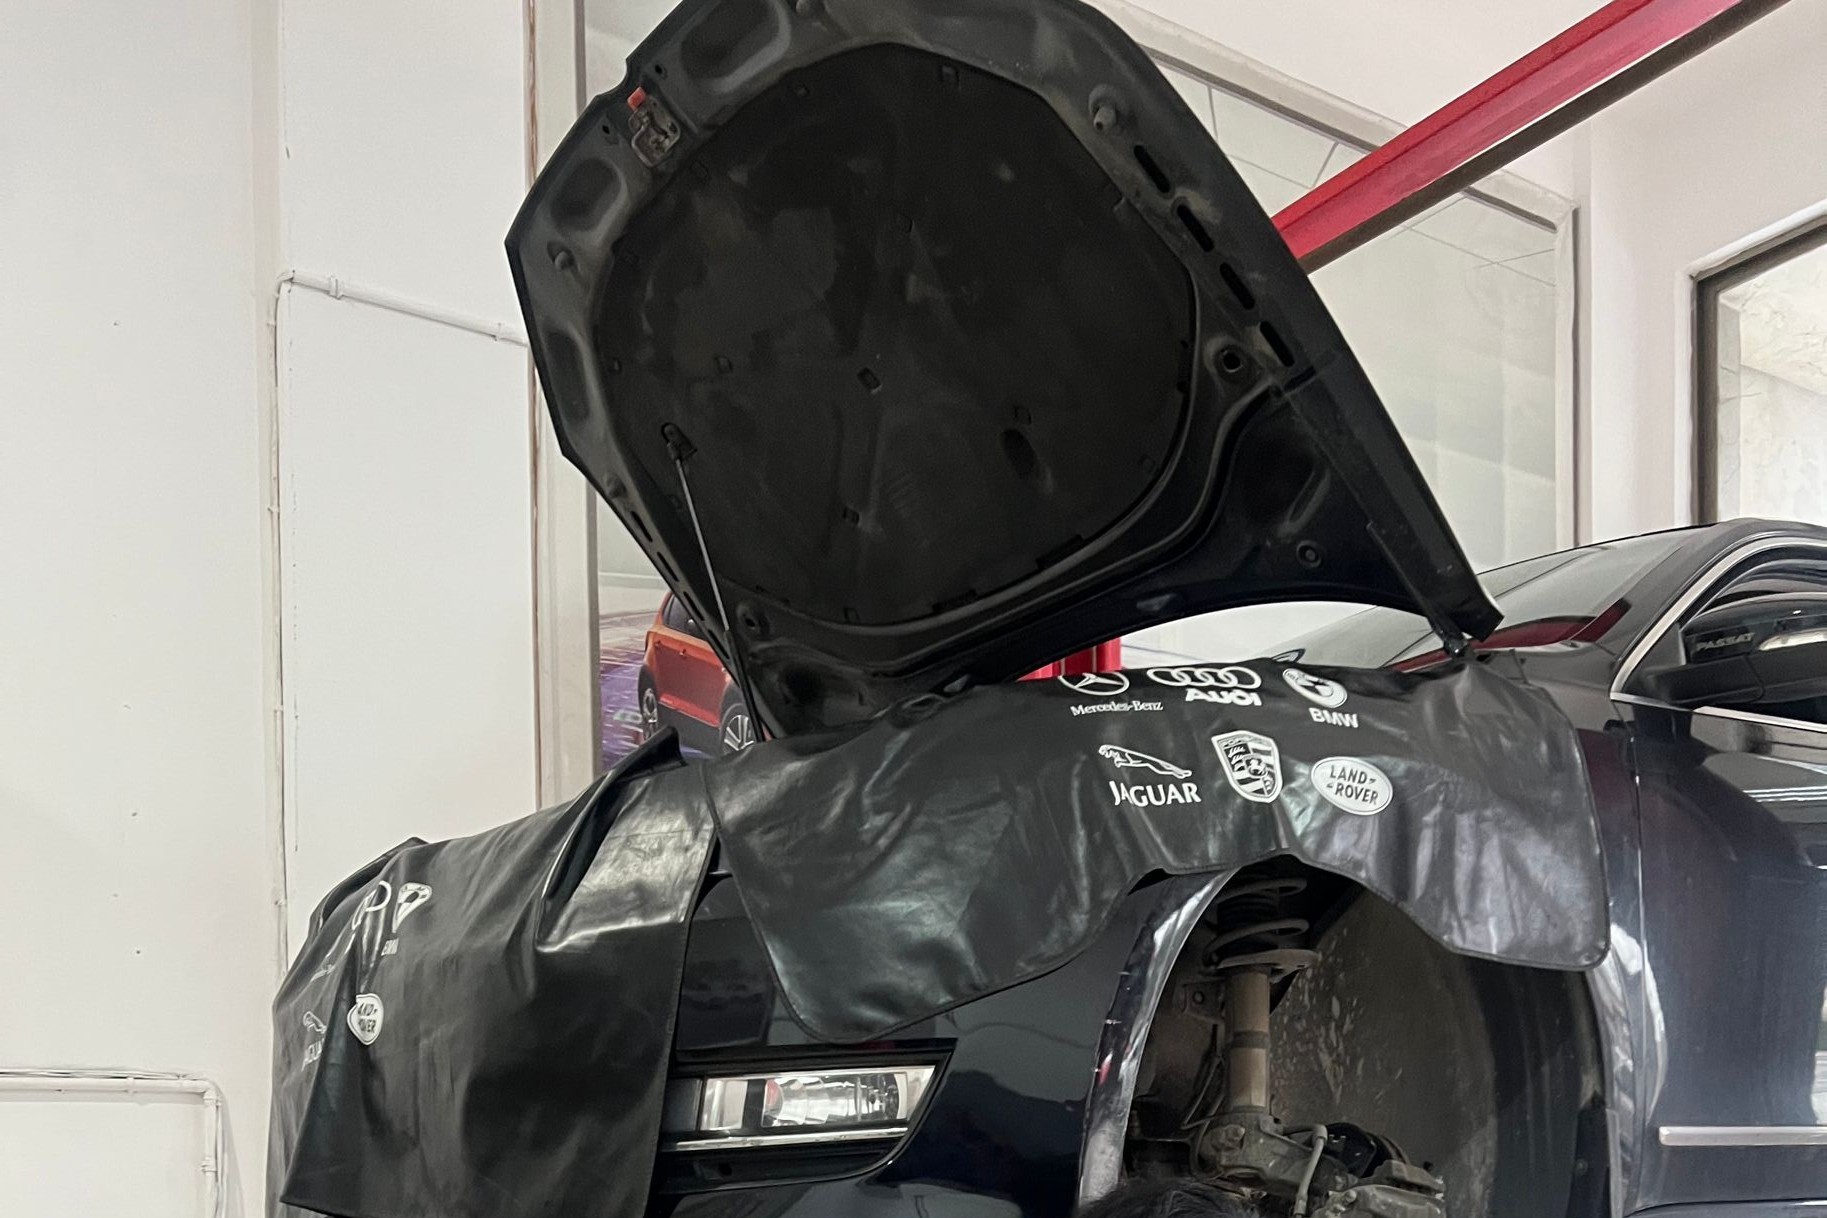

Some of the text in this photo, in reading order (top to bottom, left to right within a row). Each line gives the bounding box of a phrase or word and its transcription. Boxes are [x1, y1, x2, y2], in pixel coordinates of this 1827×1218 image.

[1070, 700, 1164, 717] Mercedes-Benz
[1308, 707, 1359, 729] BMW
[1329, 765, 1368, 784] LAND
[1109, 780, 1202, 807] JAGUAR
[1335, 782, 1379, 806] ROVER
